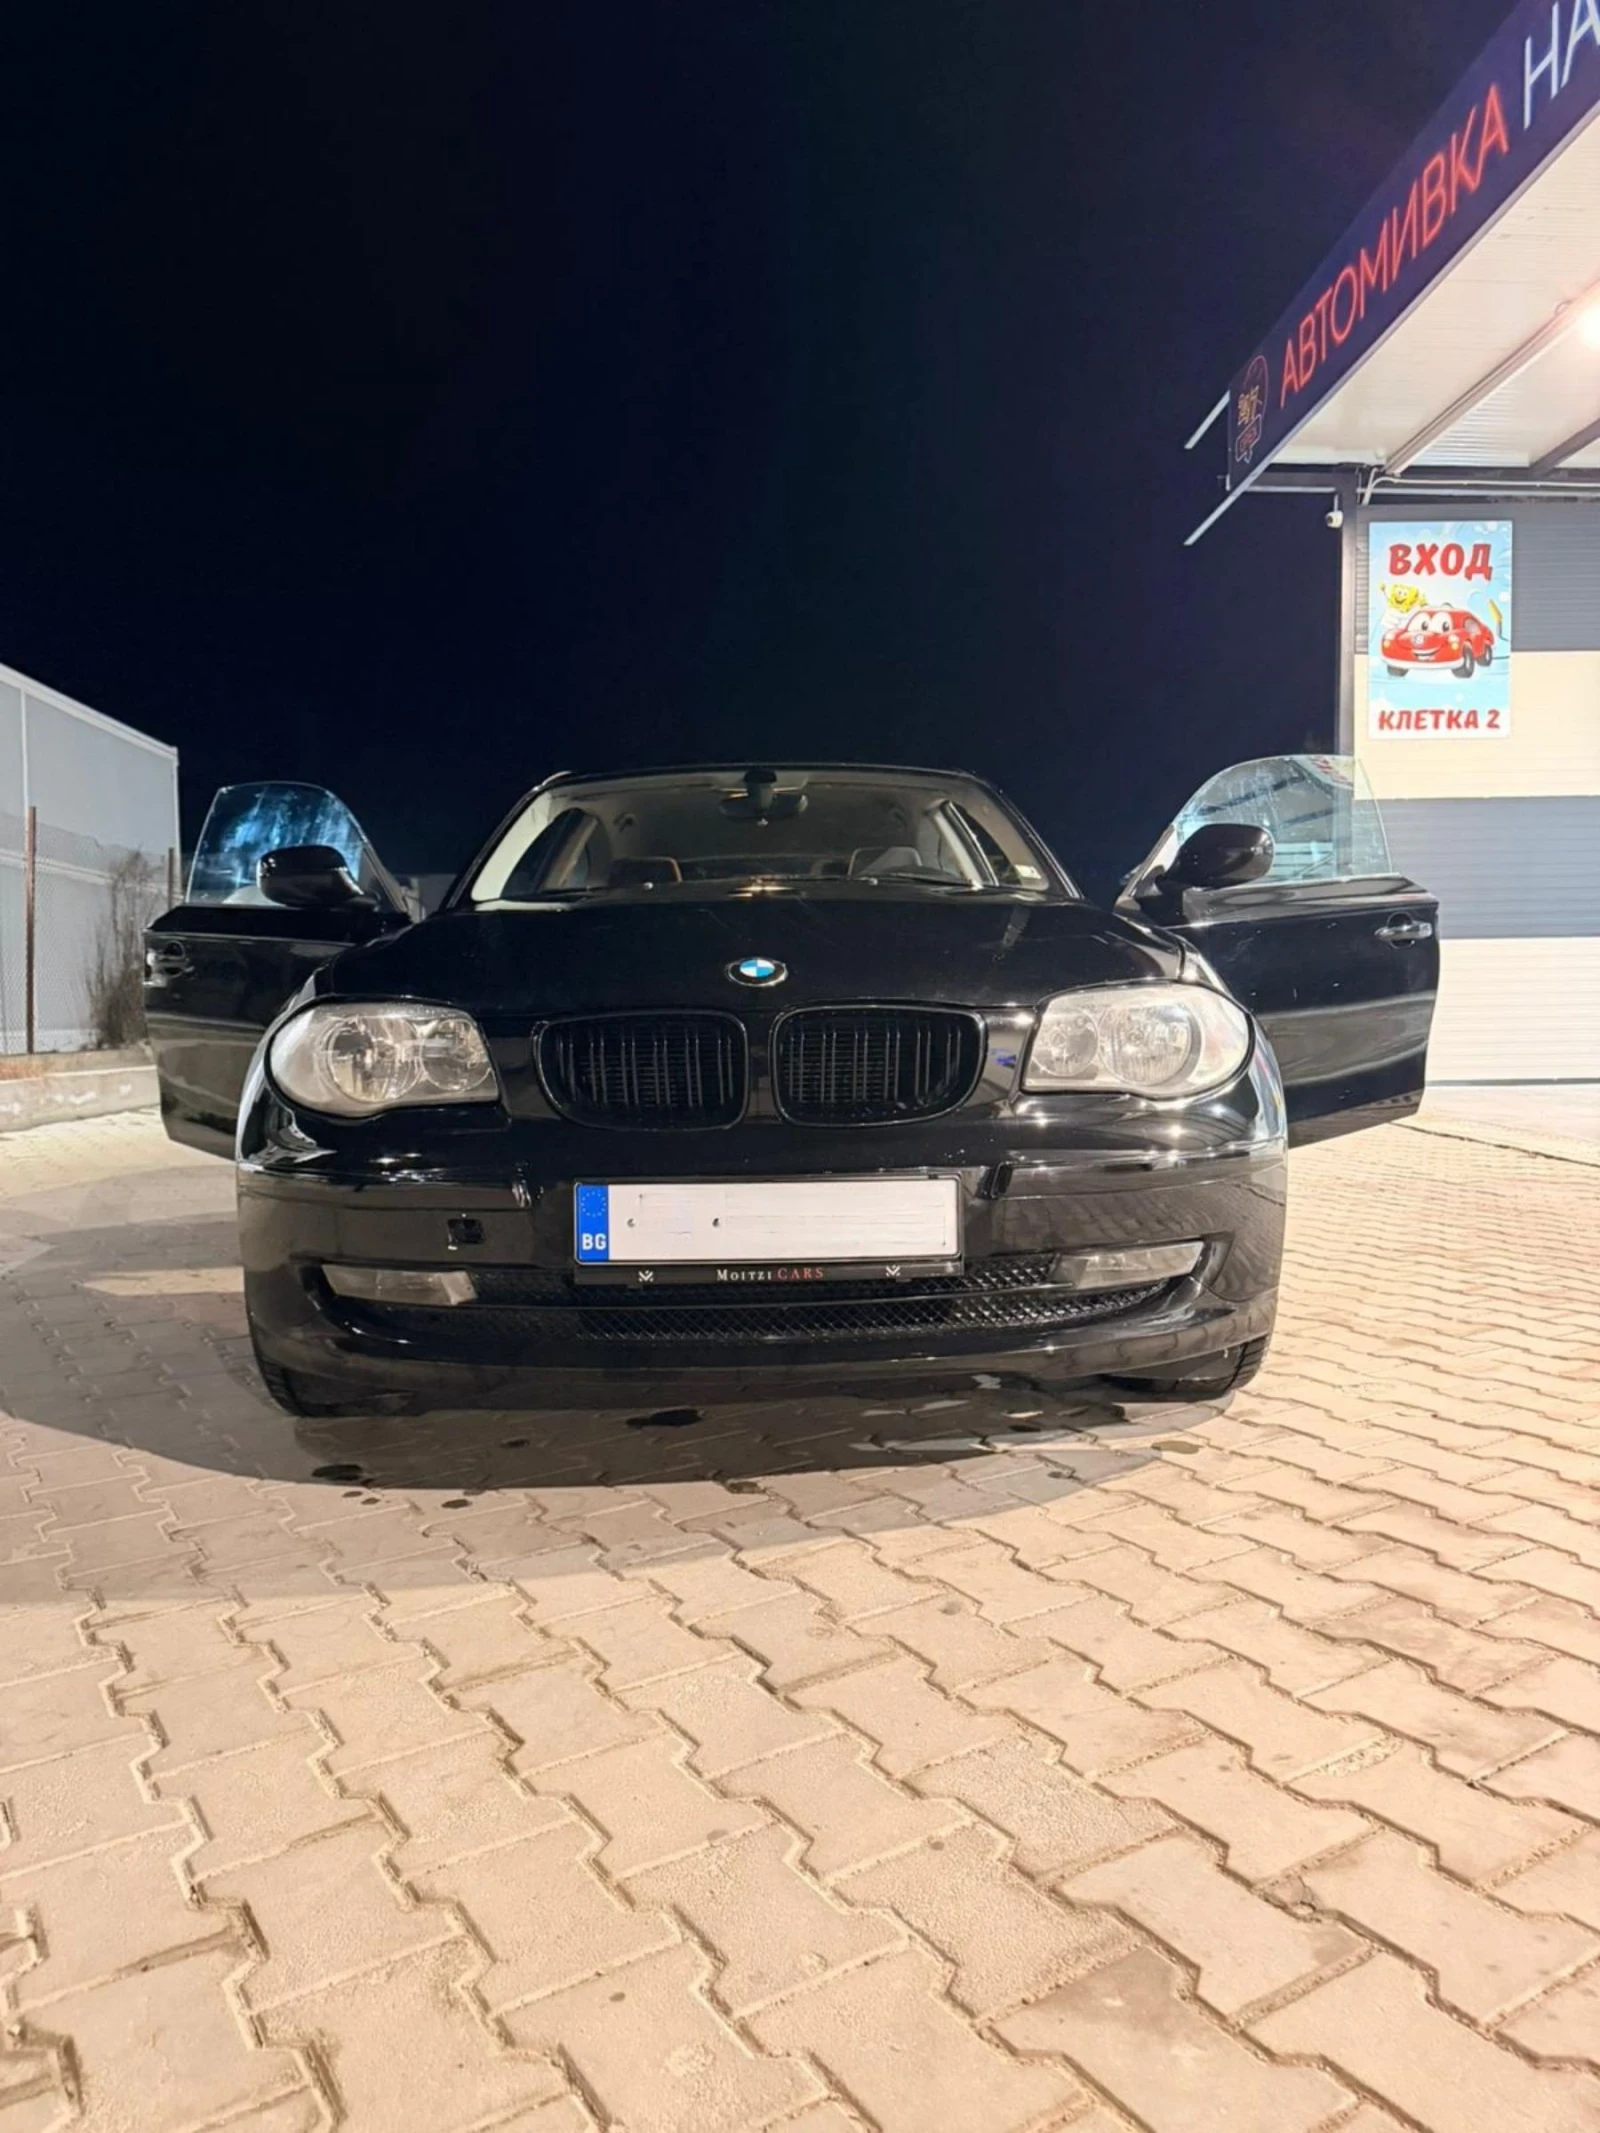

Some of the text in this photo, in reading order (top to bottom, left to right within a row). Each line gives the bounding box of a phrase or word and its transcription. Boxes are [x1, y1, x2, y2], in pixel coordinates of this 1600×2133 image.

[1280, 83, 1510, 409] АВТОМИВКА
[1389, 543, 1493, 581] ВХОД
[1378, 709, 1501, 730] КЛЕТКА 2
[582, 1233, 607, 1250] BG
[777, 1267, 824, 1279] CARS
